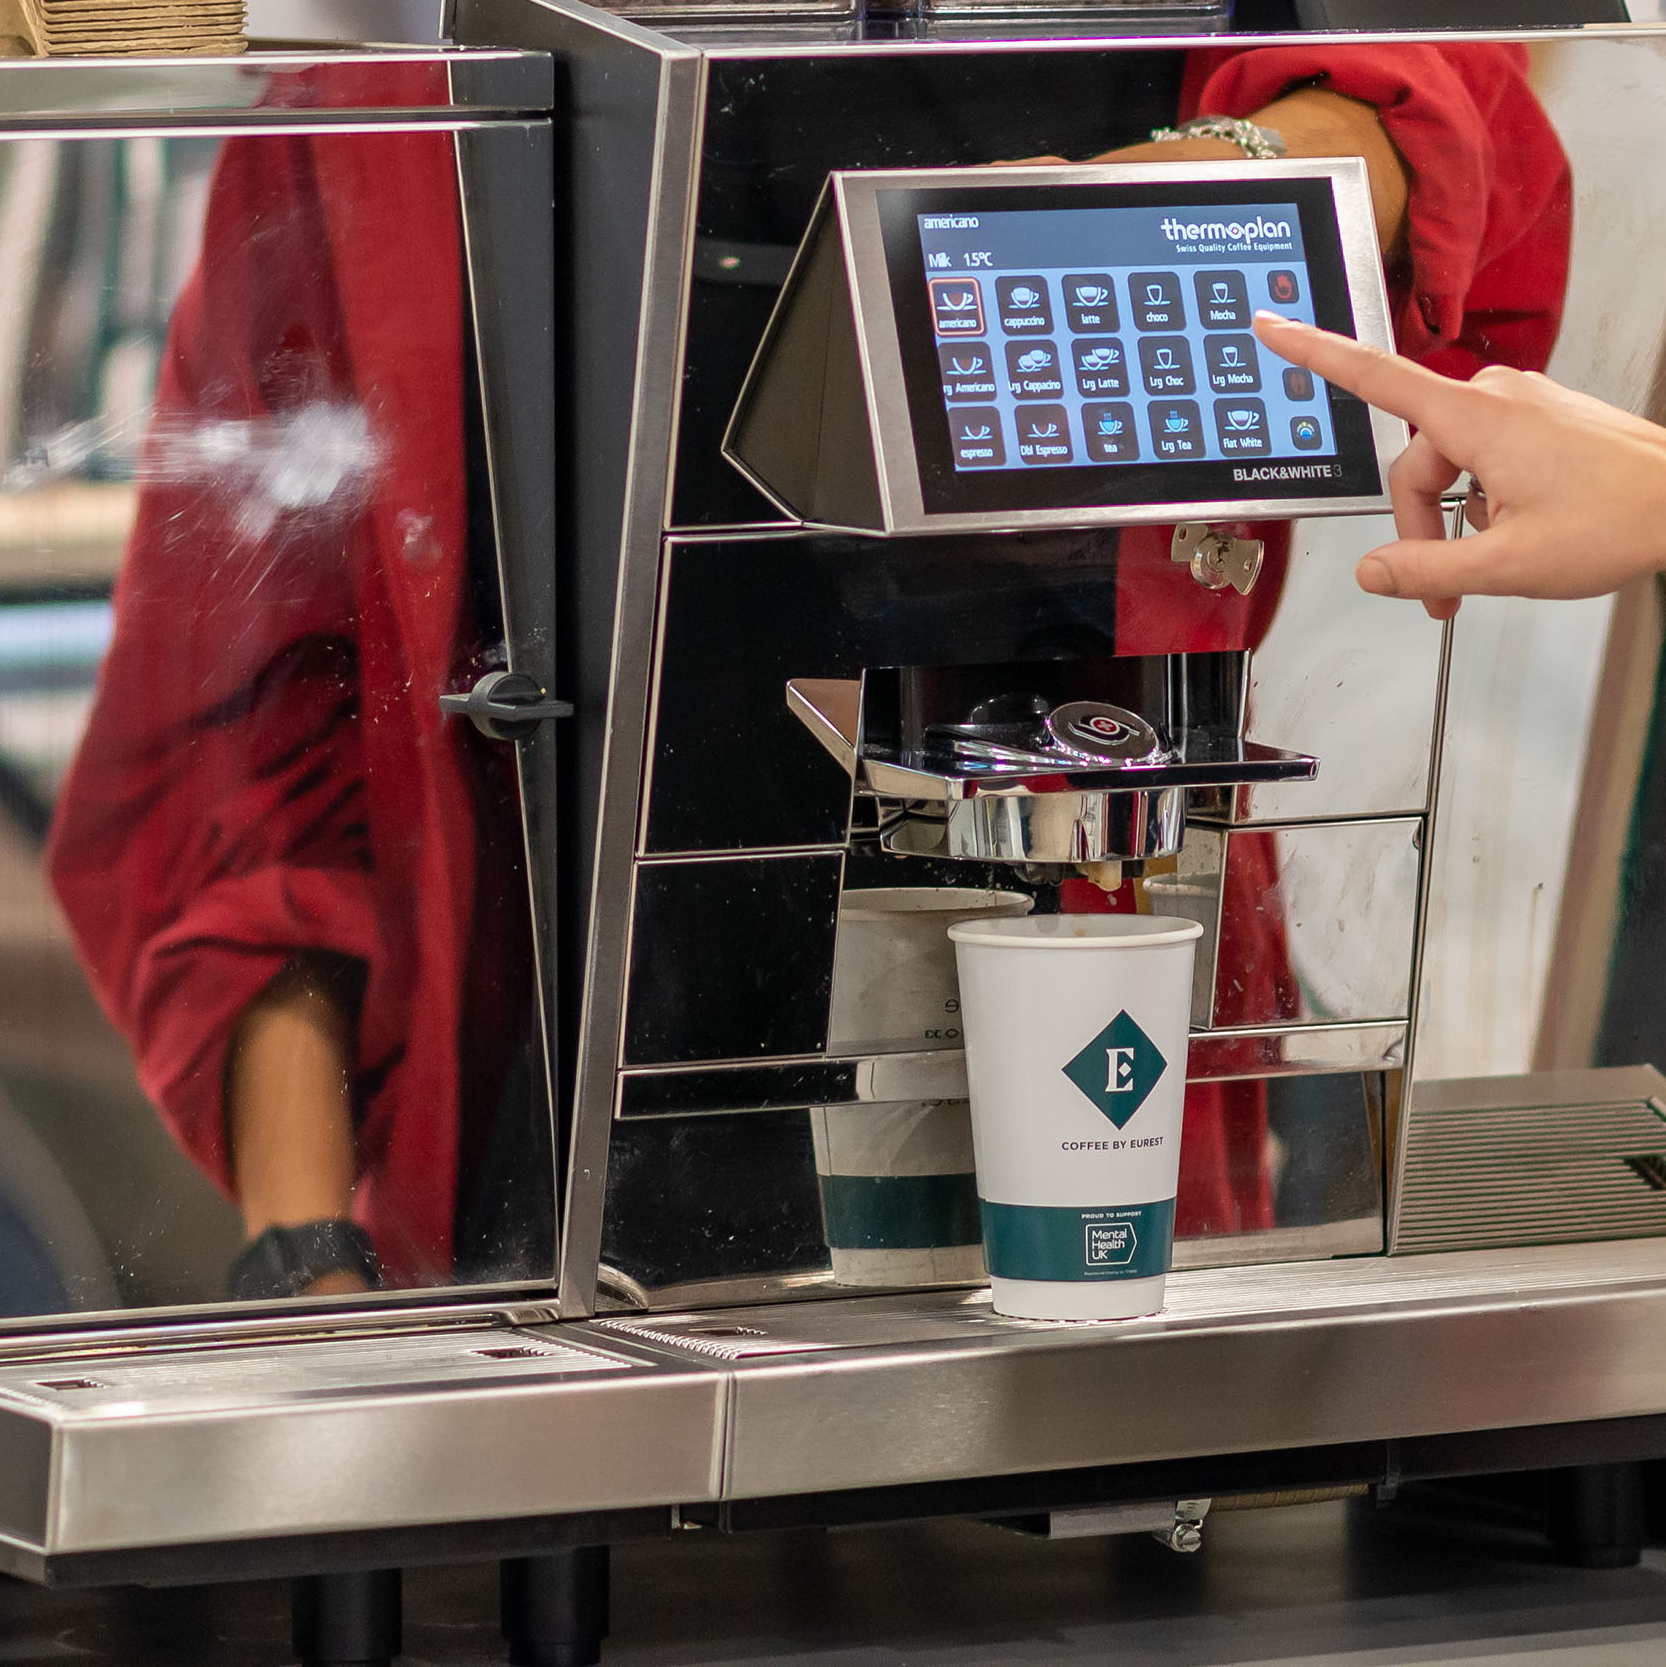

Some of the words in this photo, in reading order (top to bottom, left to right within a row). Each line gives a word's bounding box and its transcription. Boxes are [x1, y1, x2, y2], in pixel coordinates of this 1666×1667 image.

[924, 214, 979, 230] americano
[1160, 216, 1291, 244] thermoplan
[1176, 244, 1197, 253] Swiss
[1198, 243, 1226, 254] Quality
[1228, 243, 1252, 252] Coffee
[1254, 242, 1293, 253] Equipment
[1081, 314, 1101, 325] latte
[1146, 312, 1169, 323] choco
[1210, 310, 1236, 321] Mocha
[939, 317, 977, 329] americano
[1083, 379, 1096, 391] Lrg
[1098, 378, 1120, 389] Latte
[1150, 376, 1163, 389] Lrg
[1165, 375, 1184, 386] Choc
[1213, 374, 1225, 387] Lrg
[1228, 373, 1253, 384] Mocha
[956, 382, 995, 394] Americano
[1104, 444, 1118, 453] tea
[1162, 441, 1174, 454] Lrg
[1177, 440, 1192, 450] Tea
[1223, 438, 1238, 449] Flat
[1240, 437, 1263, 448] White
[961, 448, 994, 460] espresso
[1035, 445, 1068, 458] Espresso
[1105, 1047, 1134, 1092] E
[1061, 1141, 1108, 1150] COFFEE
[1113, 1140, 1127, 1149] BY
[1130, 1136, 1164, 1148] EUREST
[1092, 1229, 1127, 1240] Mental
[1092, 1239, 1125, 1250] Health
[1092, 1250, 1108, 1260] UK
